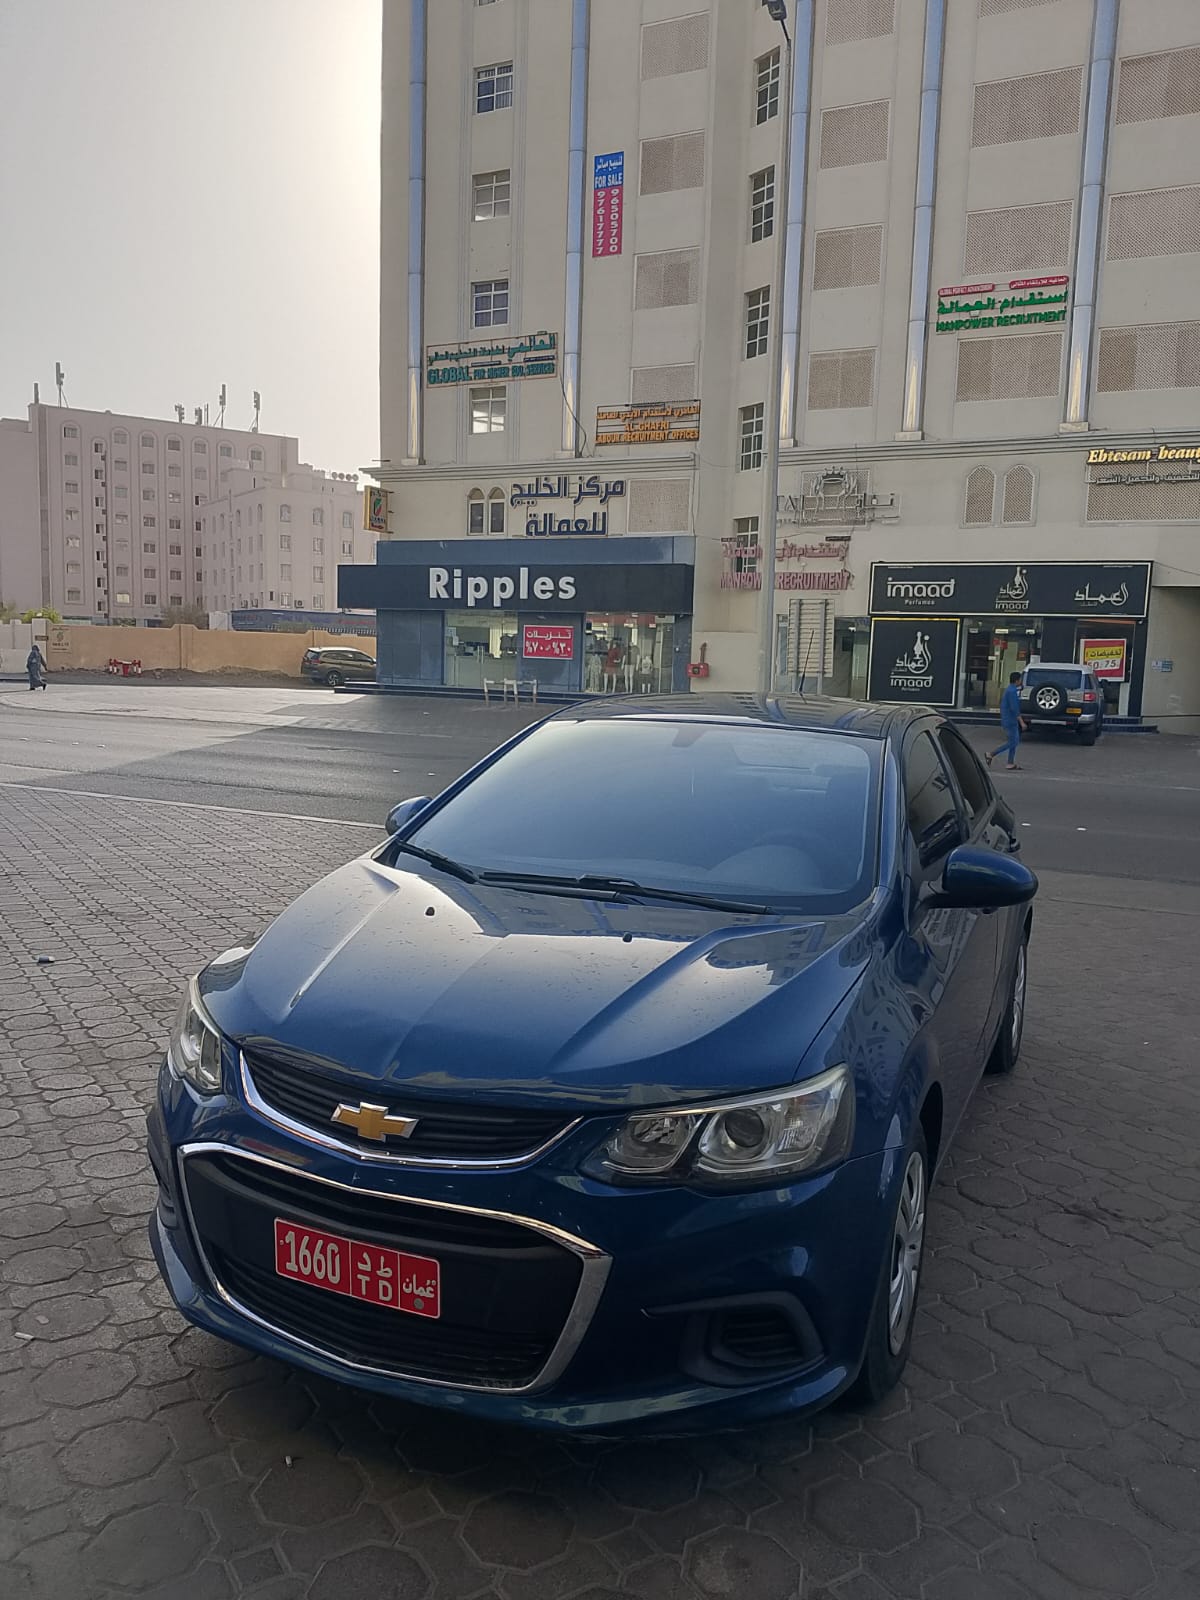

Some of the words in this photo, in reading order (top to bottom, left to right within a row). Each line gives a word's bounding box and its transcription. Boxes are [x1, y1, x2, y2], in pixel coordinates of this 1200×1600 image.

[595, 176, 606, 188] FOR
[607, 173, 622, 186] SALE
[936, 317, 994, 332] MANPOWER
[997, 309, 1067, 327] RECRUITMENT
[428, 366, 472, 384] GLOBAL
[624, 422, 634, 431] AL
[639, 421, 670, 431] GHAFRI
[624, 431, 670, 441] RECRUITMENT
[672, 429, 699, 438] OFFICES
[511, 477, 567, 506] الخليج
[574, 476, 624, 504] مركز
[526, 512, 606, 535] للعمالة
[429, 567, 576, 606] Ripples
[777, 572, 849, 590] RECRUITMENT
[887, 577, 955, 597] imaad
[996, 598, 1029, 609] imaad
[526, 629, 571, 640] تنزيلات
[890, 672, 933, 688] imaad
[285, 1231, 341, 1284] 1660
